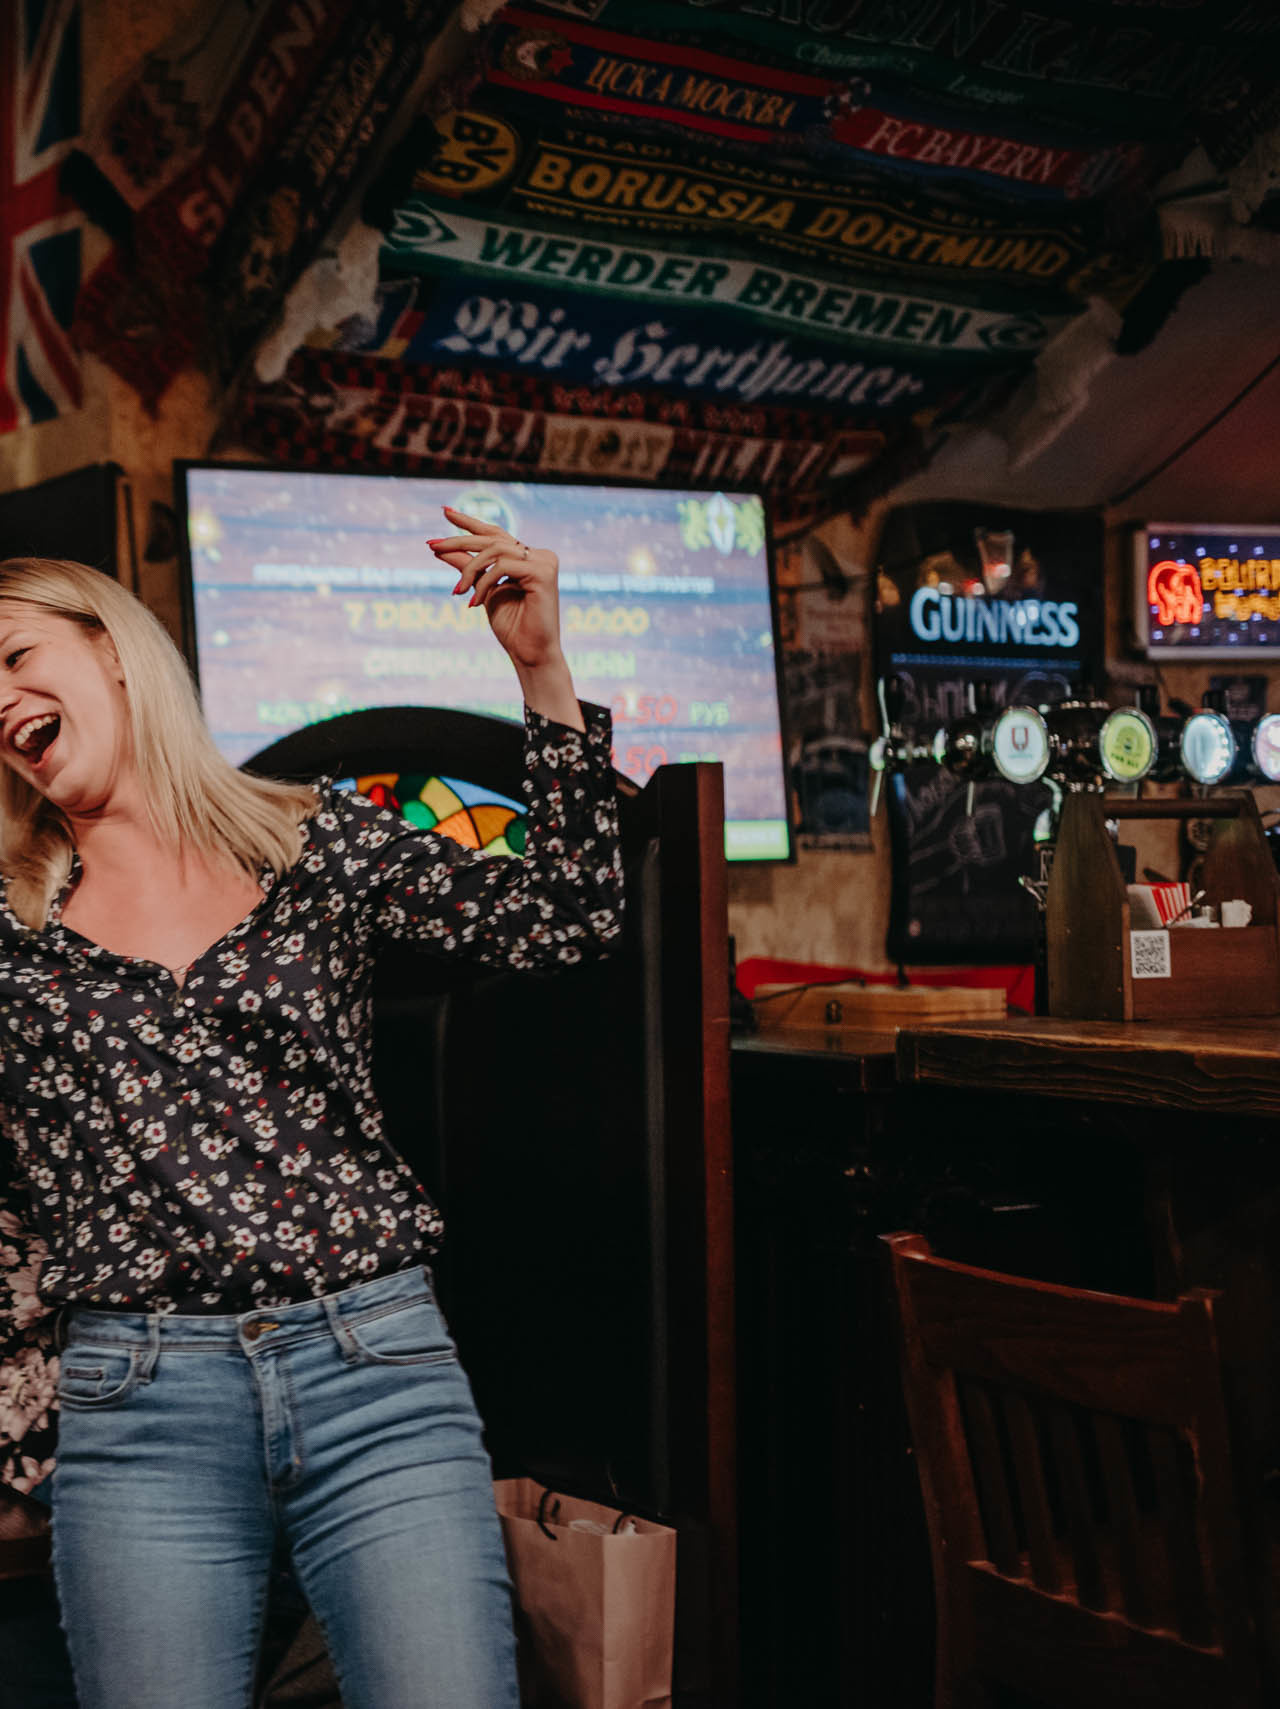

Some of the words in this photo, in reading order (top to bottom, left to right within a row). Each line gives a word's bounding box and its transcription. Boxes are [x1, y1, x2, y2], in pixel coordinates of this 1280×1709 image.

[584, 56, 672, 104] ЦСКА
[673, 72, 800, 129] МОСКВА
[858, 112, 925, 154] FC
[916, 124, 1070, 184] BAYERN
[528, 149, 797, 232] BORUSSIA
[802, 204, 1073, 279] DORTMUND
[480, 226, 731, 297] WERDER
[737, 263, 972, 347] BREMEN
[433, 295, 592, 368] Wir
[344, 602, 365, 630] 7
[909, 585, 1081, 648] GUINNESS
[610, 693, 679, 726] 250
[612, 744, 669, 777] 50
